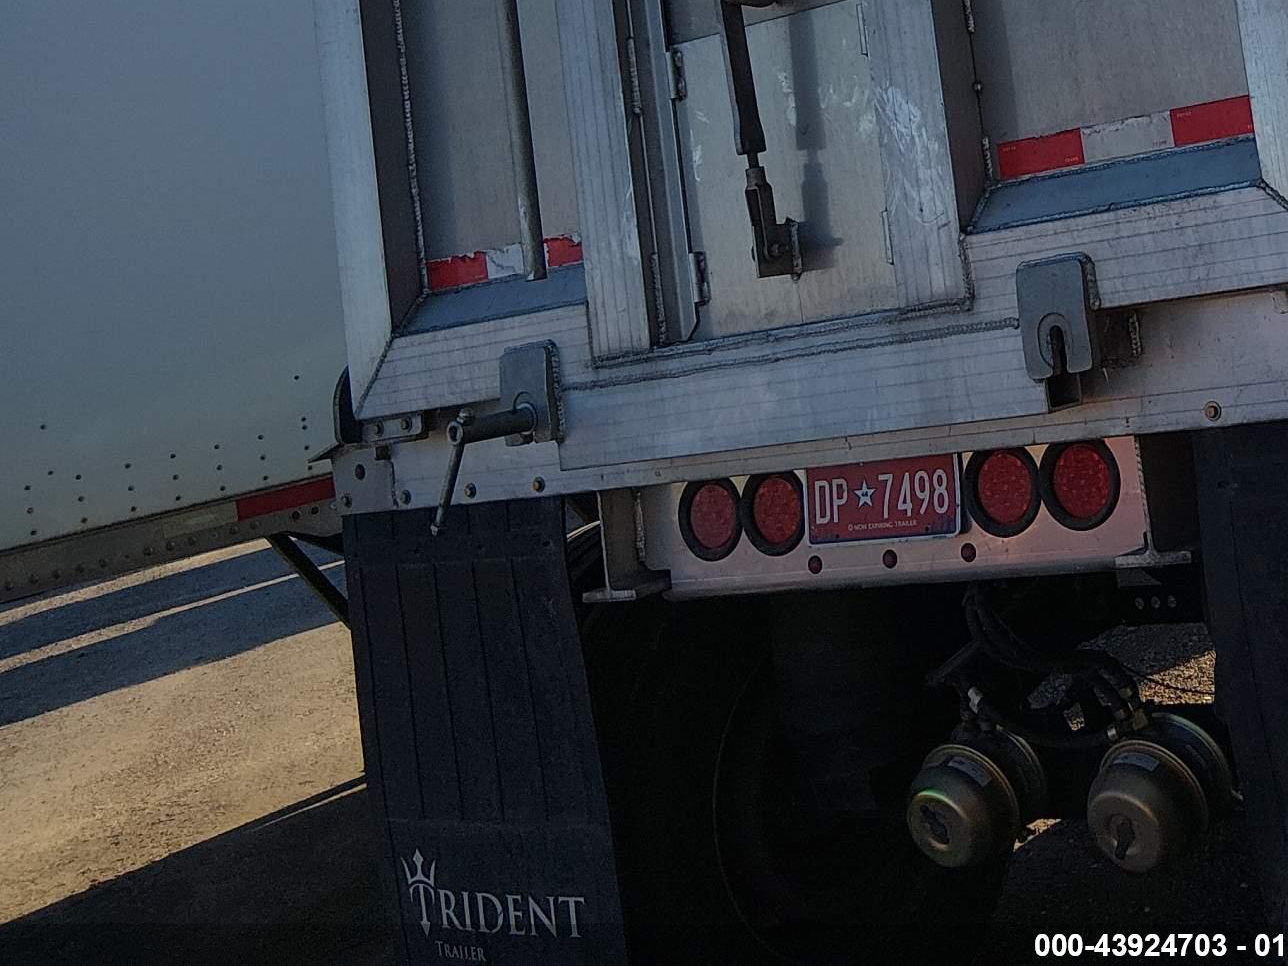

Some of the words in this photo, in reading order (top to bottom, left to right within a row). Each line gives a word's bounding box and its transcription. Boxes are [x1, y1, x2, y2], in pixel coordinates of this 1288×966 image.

[814, 478, 848, 525] DP
[878, 468, 949, 519] 7498
[408, 882, 585, 938] TRIDENT
[434, 940, 487, 962] TRAILER
